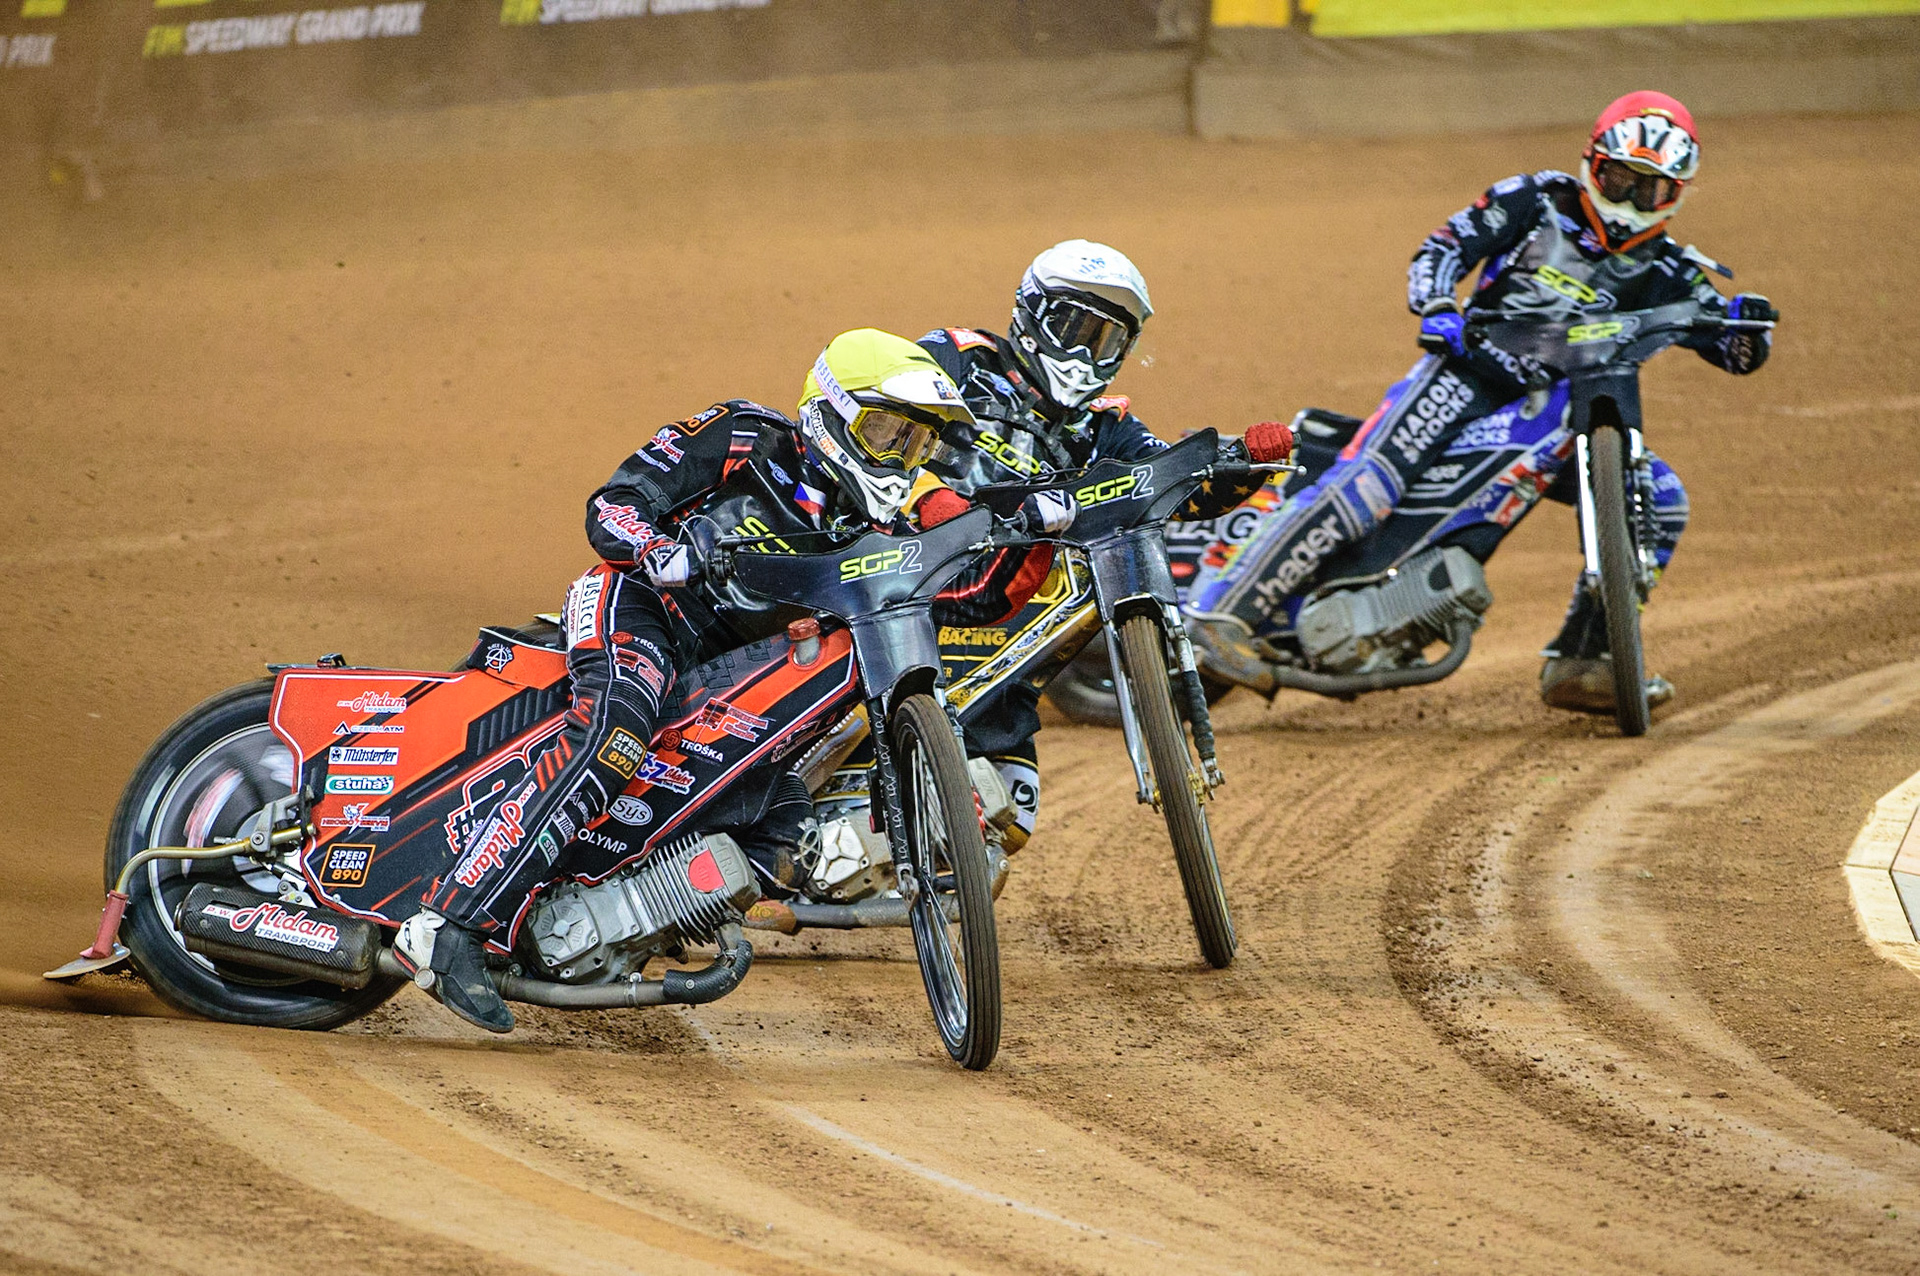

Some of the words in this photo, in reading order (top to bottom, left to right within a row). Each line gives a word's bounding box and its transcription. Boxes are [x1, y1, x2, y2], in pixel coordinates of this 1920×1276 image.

[1391, 370, 1460, 450] HAGON
[1076, 465, 1154, 507] SGP2
[839, 540, 922, 581] SGP2
[938, 629, 1008, 646] RACING
[352, 691, 405, 711] Midam
[612, 741, 641, 763] CLEAN
[615, 733, 643, 754] SPEED
[681, 739, 724, 763] TROŠKA
[608, 751, 633, 771] 890
[335, 778, 380, 790] stuha
[613, 800, 648, 820] Sýs
[456, 819, 500, 880] TRANSPORT
[460, 802, 524, 886] Midam
[577, 828, 628, 854] OLYMP
[329, 859, 365, 870] CLEAN
[332, 850, 367, 861] SPEED
[331, 869, 362, 881] 890
[231, 903, 338, 941] Midam
[257, 928, 334, 951] TRANSPORT
